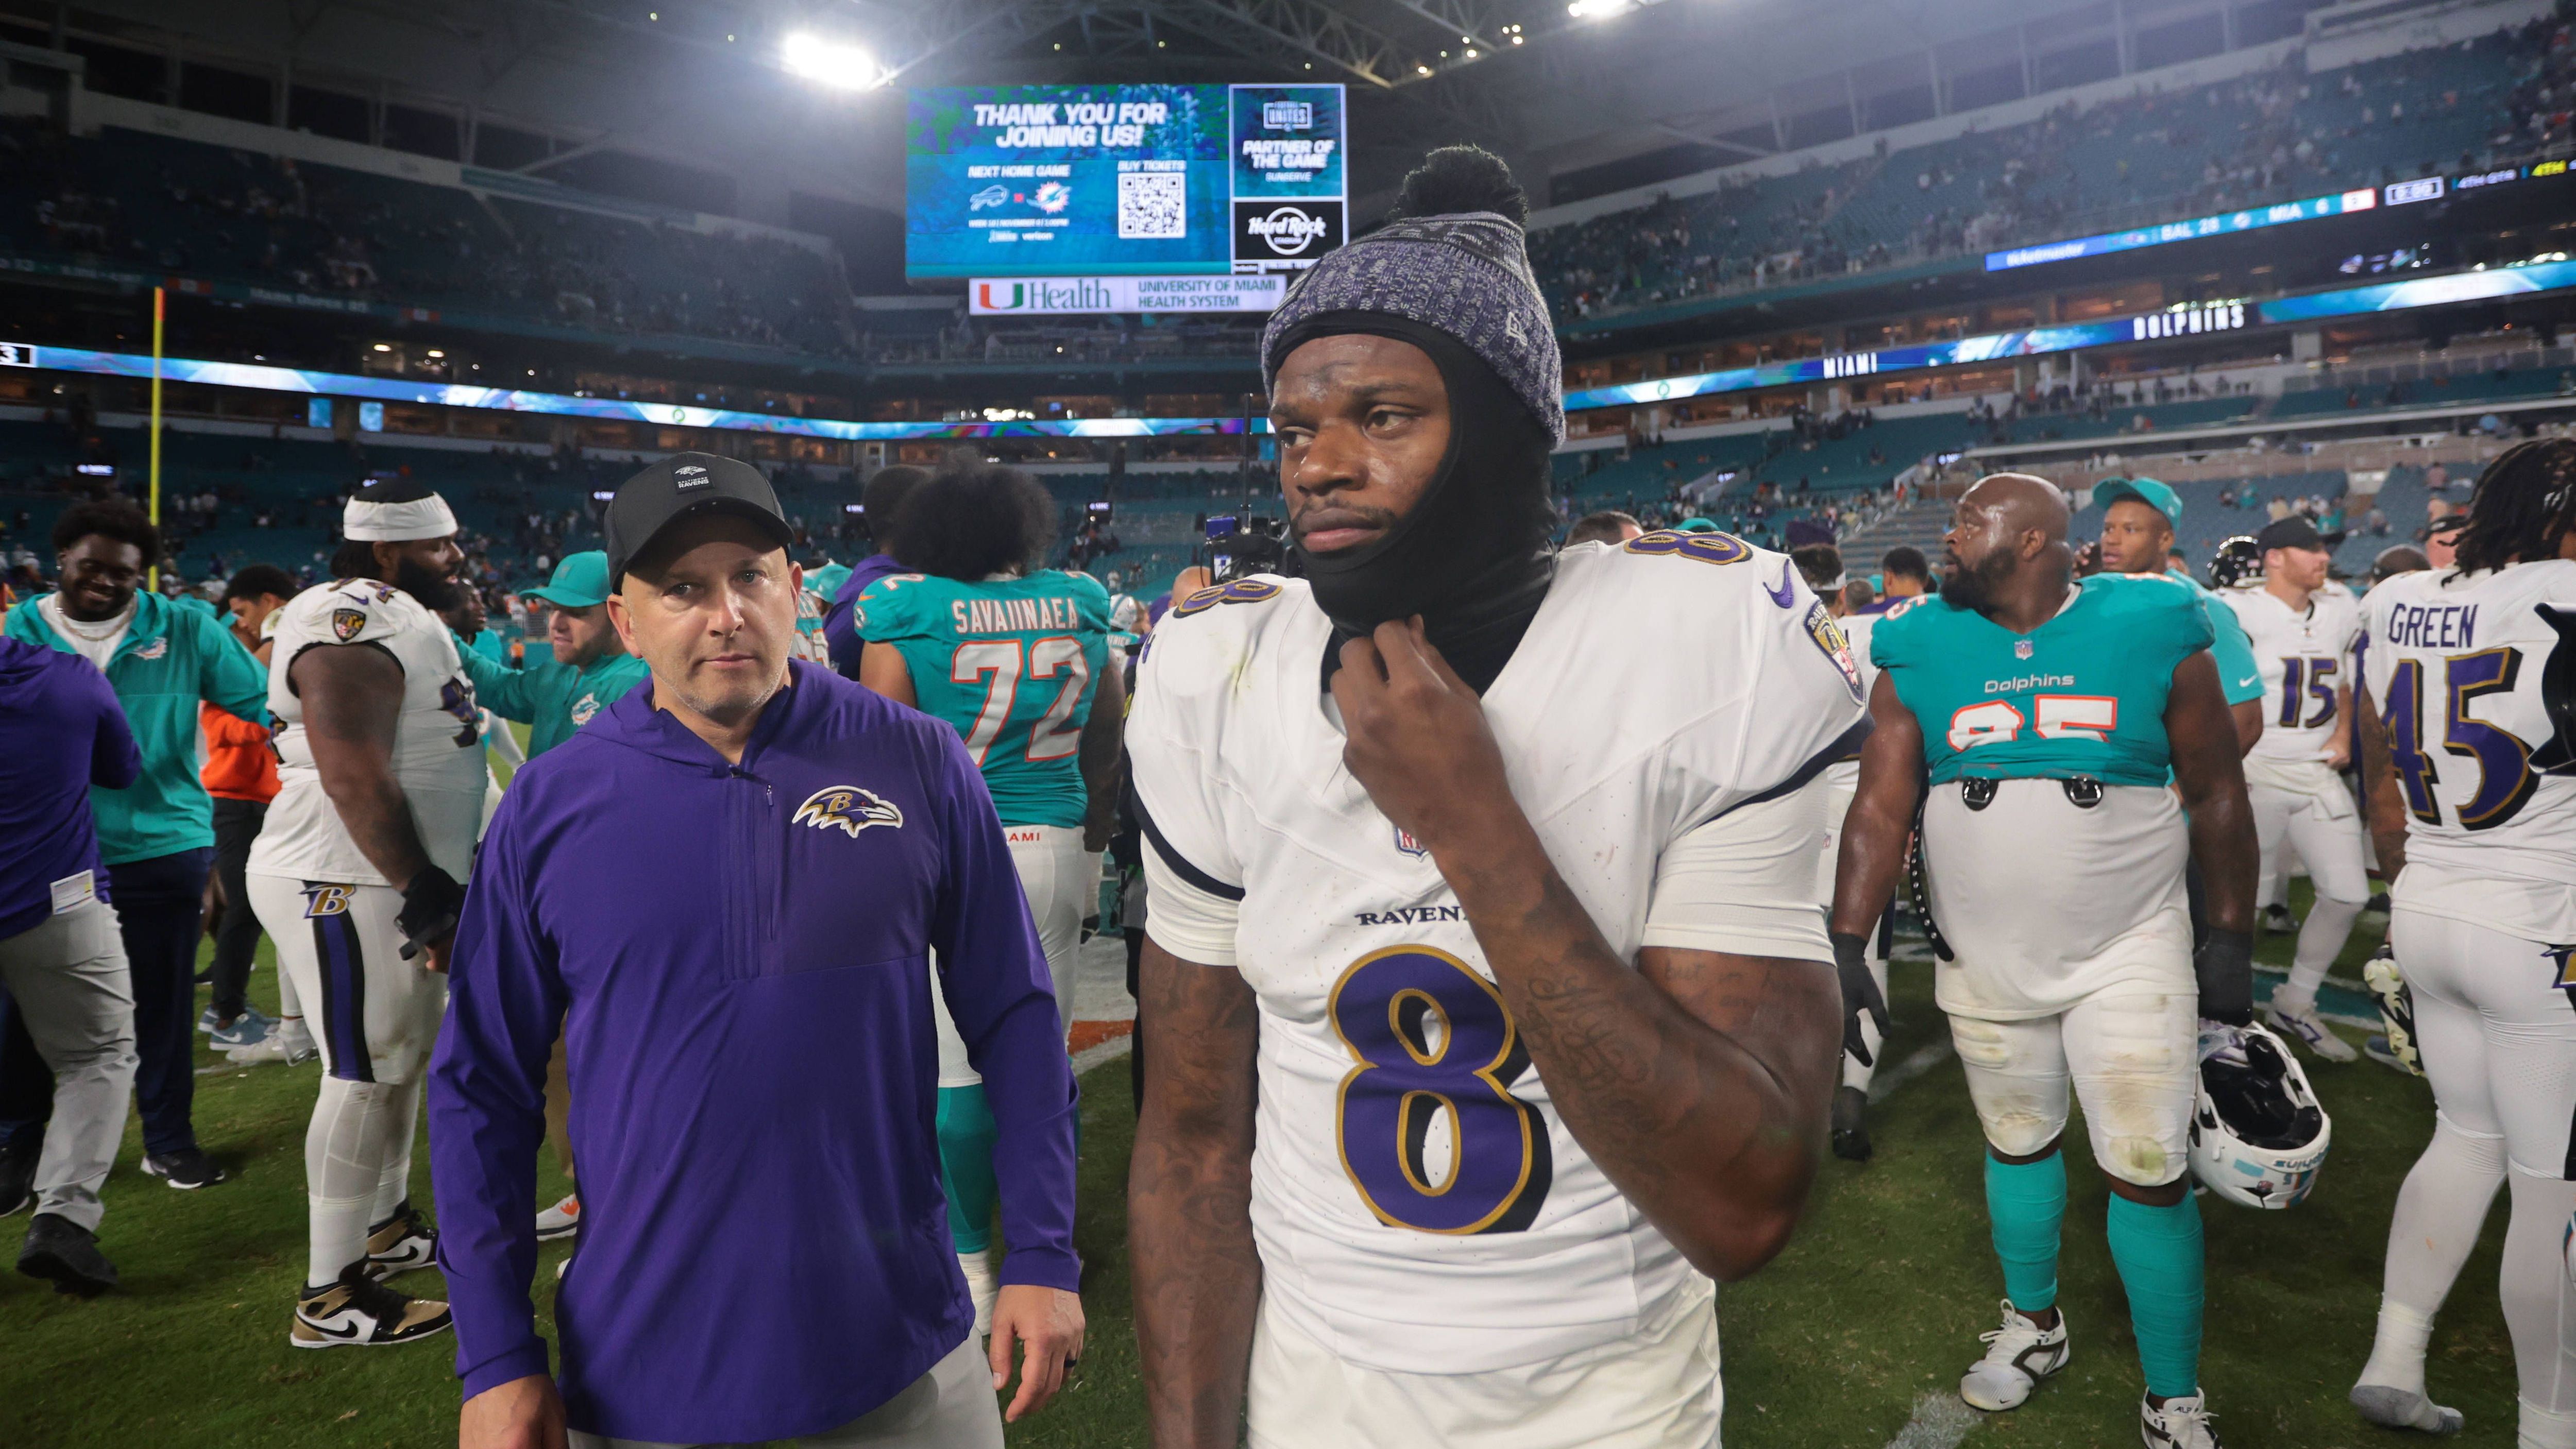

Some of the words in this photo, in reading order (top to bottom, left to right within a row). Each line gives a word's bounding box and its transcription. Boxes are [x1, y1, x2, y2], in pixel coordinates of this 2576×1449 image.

[974, 104, 1059, 126] THANK
[1064, 103, 1116, 125] YOU
[1118, 103, 1167, 125] FOR
[996, 125, 1097, 148] JOINING
[1101, 125, 1145, 147] US!
[1242, 140, 1313, 155] PARTNER
[1313, 140, 1335, 154] OF
[968, 165, 1000, 178] NEXT
[1001, 165, 1035, 177] HOME
[1036, 165, 1071, 177] GAME
[1118, 161, 1141, 171] BUY
[1143, 160, 1187, 171] TICKETS
[1251, 154, 1281, 168] THE
[1282, 154, 1328, 168] GAME
[1248, 216, 1289, 235] Hard
[1288, 216, 1327, 237] Rock
[2007, 243, 2085, 267] ticketmaster
[2161, 222, 2193, 242] BAL
[2199, 217, 2220, 234] 28
[2268, 202, 2302, 222] MIA
[1139, 280, 1212, 293] UNIVERSITY
[1215, 279, 1231, 292] OF
[1235, 278, 1277, 292] MIAMI
[1139, 295, 1186, 309] HEALTH
[1189, 294, 1239, 308] SYSTEM
[2133, 305, 2244, 340] DOLPHINS
[1823, 352, 1877, 379] MIAMI
[679, 479, 708, 488] RAVENS
[952, 597, 1079, 634] SAVAIINAEA
[2388, 603, 2478, 648] GREEN
[1984, 673, 2076, 693] Dolphins
[2279, 657, 2338, 728] 15
[951, 635, 1090, 766] 72
[2381, 646, 2545, 831] 45
[1008, 832, 1040, 842] AMI
[1354, 906, 1468, 926] RAVEN
[1327, 943, 1553, 1236] 8
